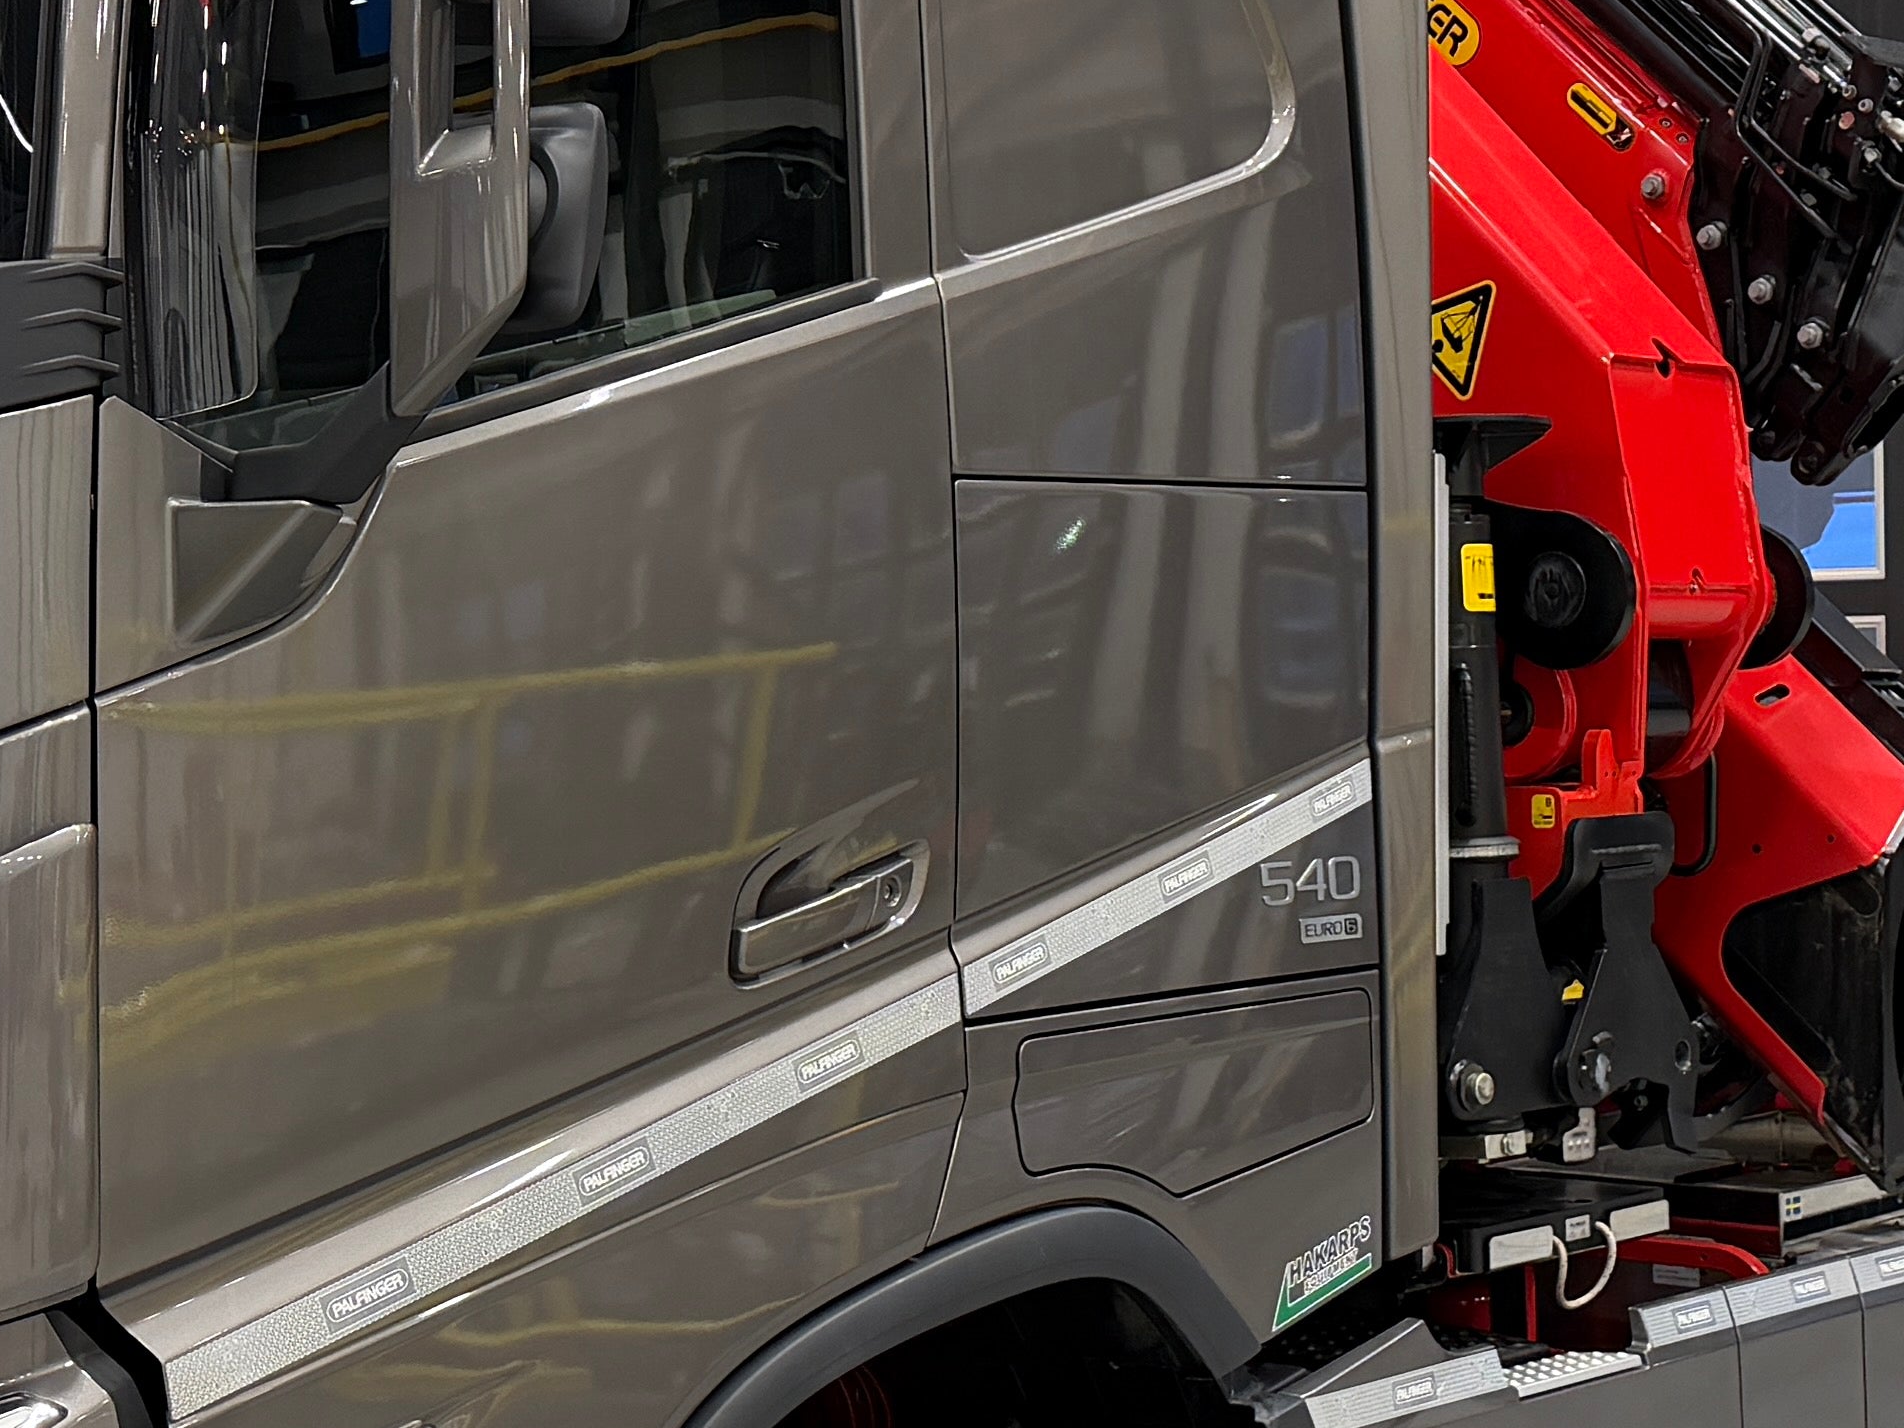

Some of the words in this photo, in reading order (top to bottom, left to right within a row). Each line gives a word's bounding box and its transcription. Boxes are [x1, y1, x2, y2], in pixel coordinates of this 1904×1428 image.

[1260, 856, 1361, 906] 540
[1304, 921, 1342, 938] EURO
[800, 1040, 858, 1081] PALFINGER
[582, 1148, 647, 1194] PALFINGER
[1287, 1215, 1371, 1289] HAKARPS
[331, 1271, 405, 1320] PALFINGER
